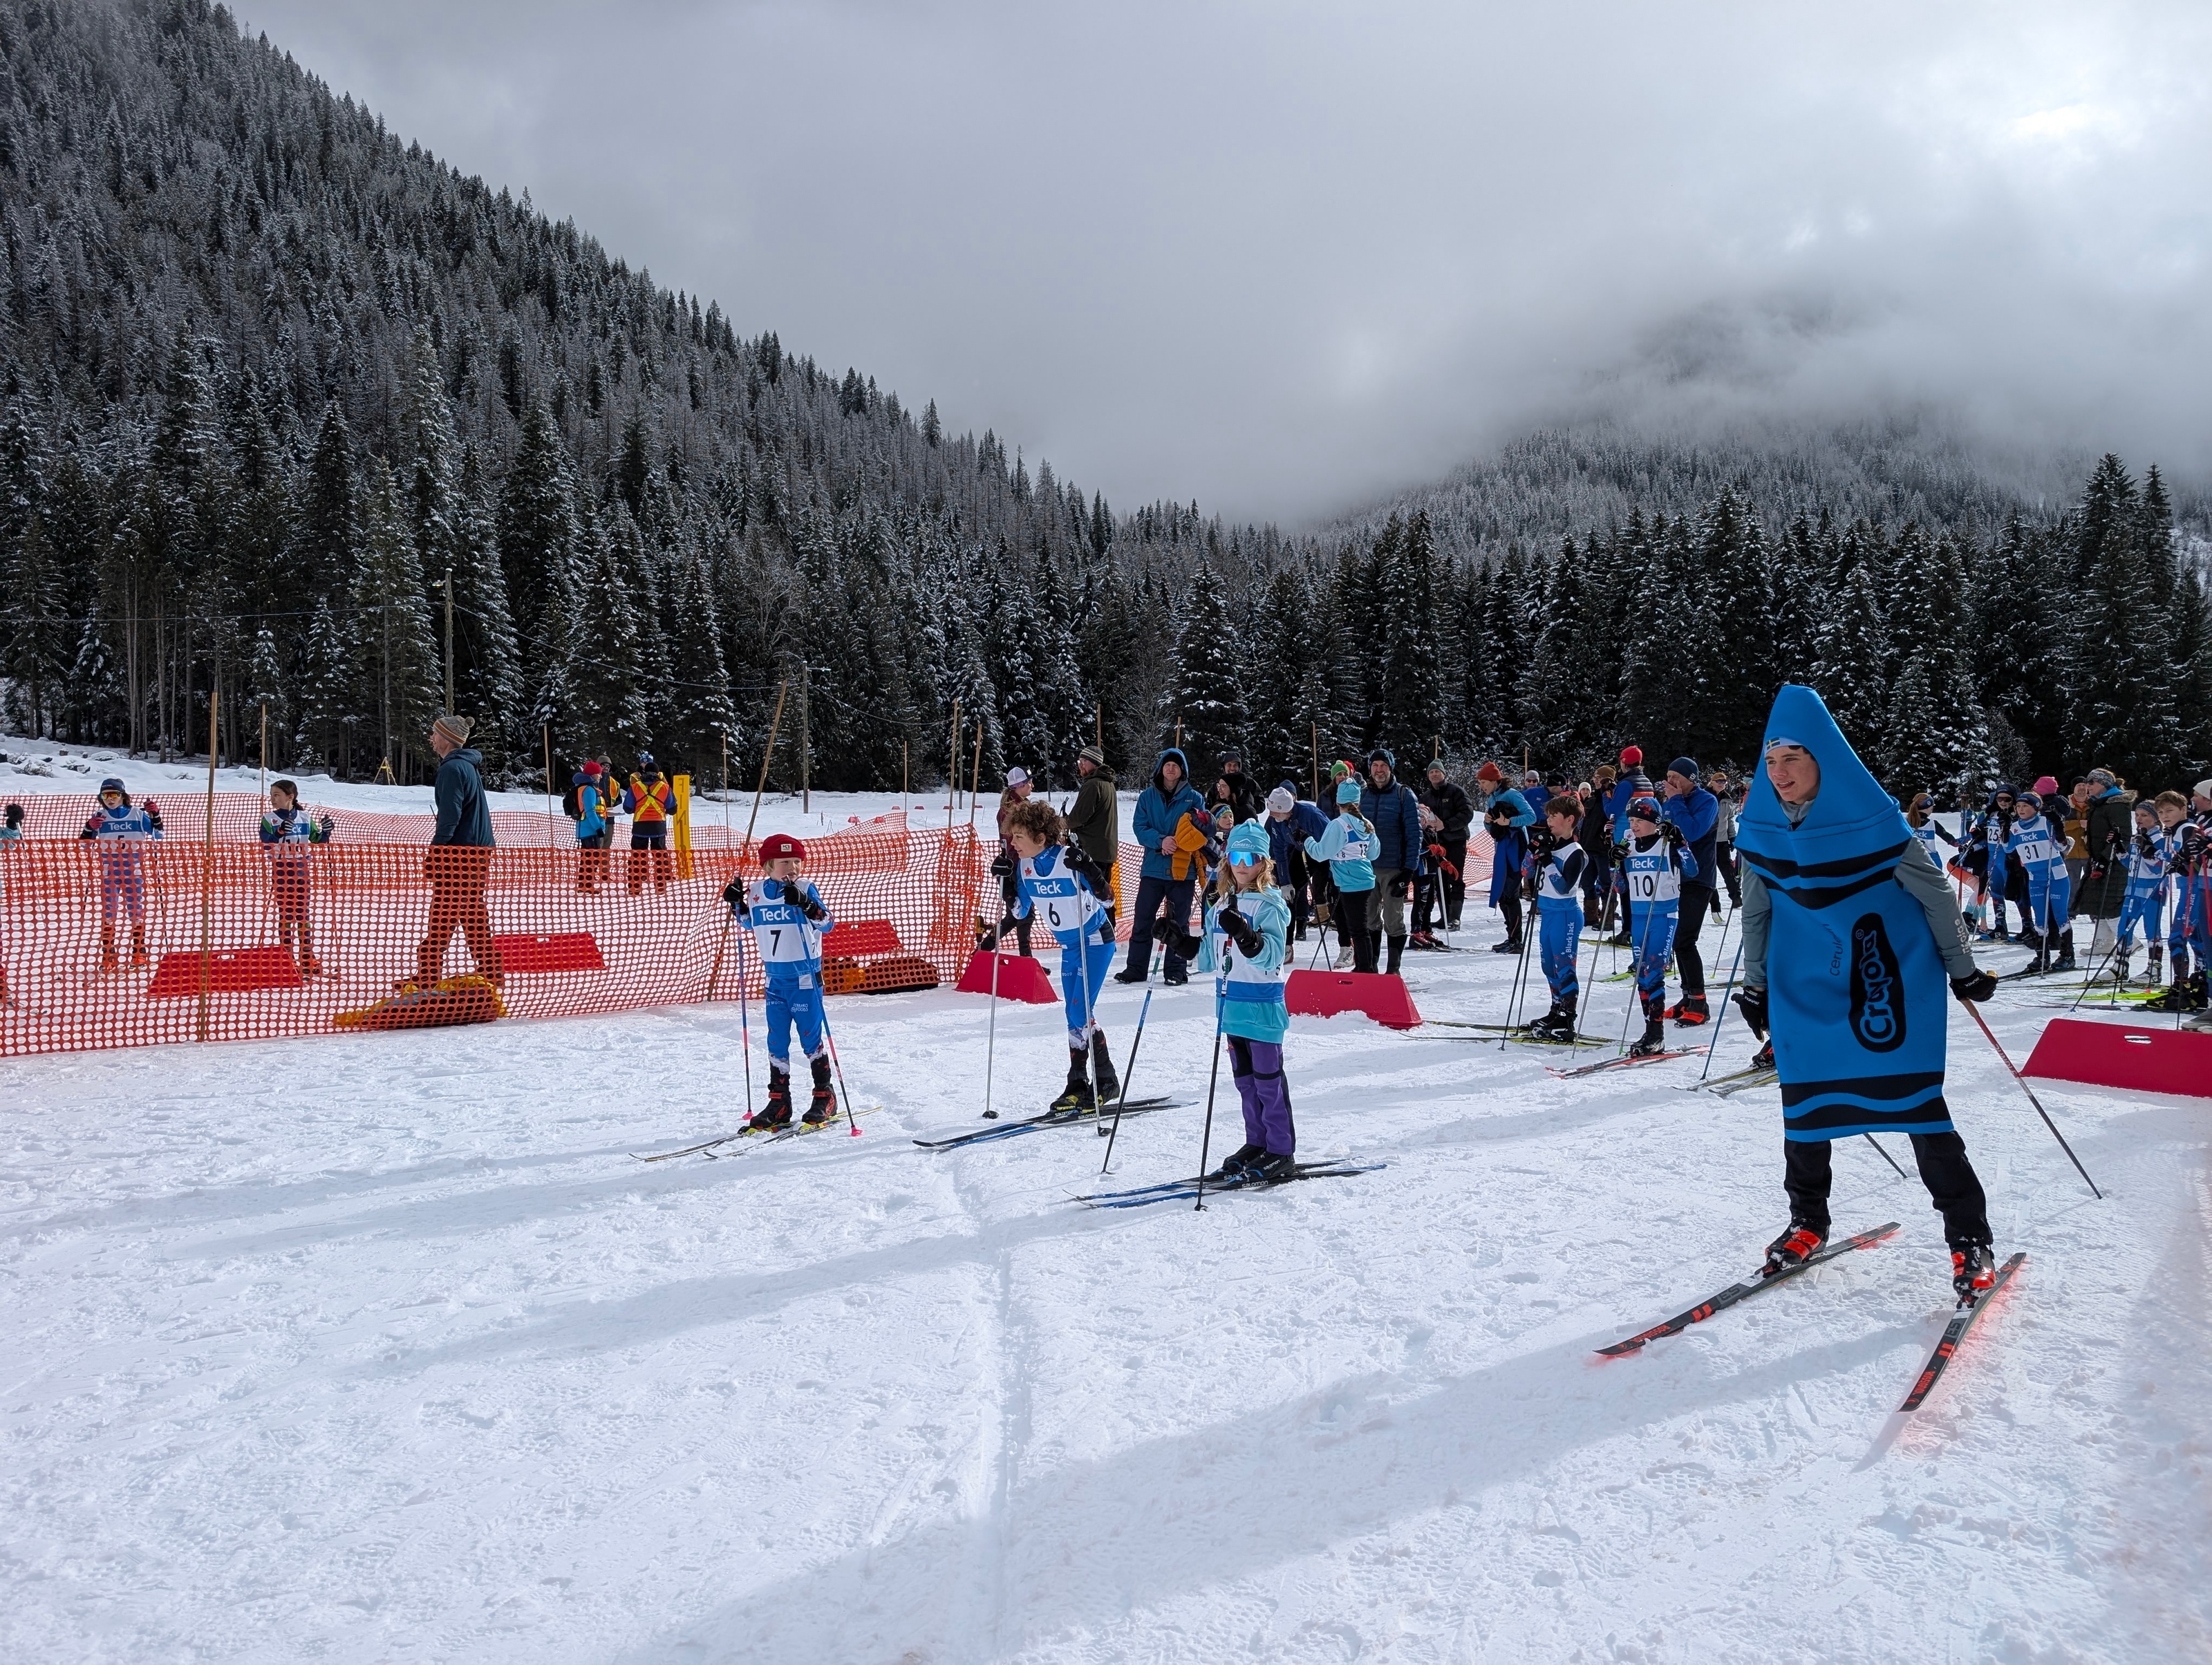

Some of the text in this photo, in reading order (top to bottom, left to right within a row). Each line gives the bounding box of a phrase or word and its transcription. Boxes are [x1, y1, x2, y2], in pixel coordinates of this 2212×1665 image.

[108, 822, 132, 831] Teck
[292, 825, 302, 834] ck
[1988, 828, 1999, 842] 25
[2020, 832, 2038, 842] Teck
[118, 835, 126, 850] 5
[2025, 845, 2040, 860] 31
[1631, 857, 1655, 869] Teck
[1033, 881, 1062, 894] Teck
[1633, 874, 1653, 897] 10
[760, 906, 791, 921] Teck
[1049, 902, 1061, 927] 6
[1085, 903, 1091, 912] 6
[1567, 921, 1575, 936] Jack
[770, 930, 782, 957] 7
[812, 942, 816, 954] 7
[1662, 939, 1671, 957] Black
[1859, 930, 1897, 1043] Crayola
[1521, 1038, 1574, 1046] FISCHER
